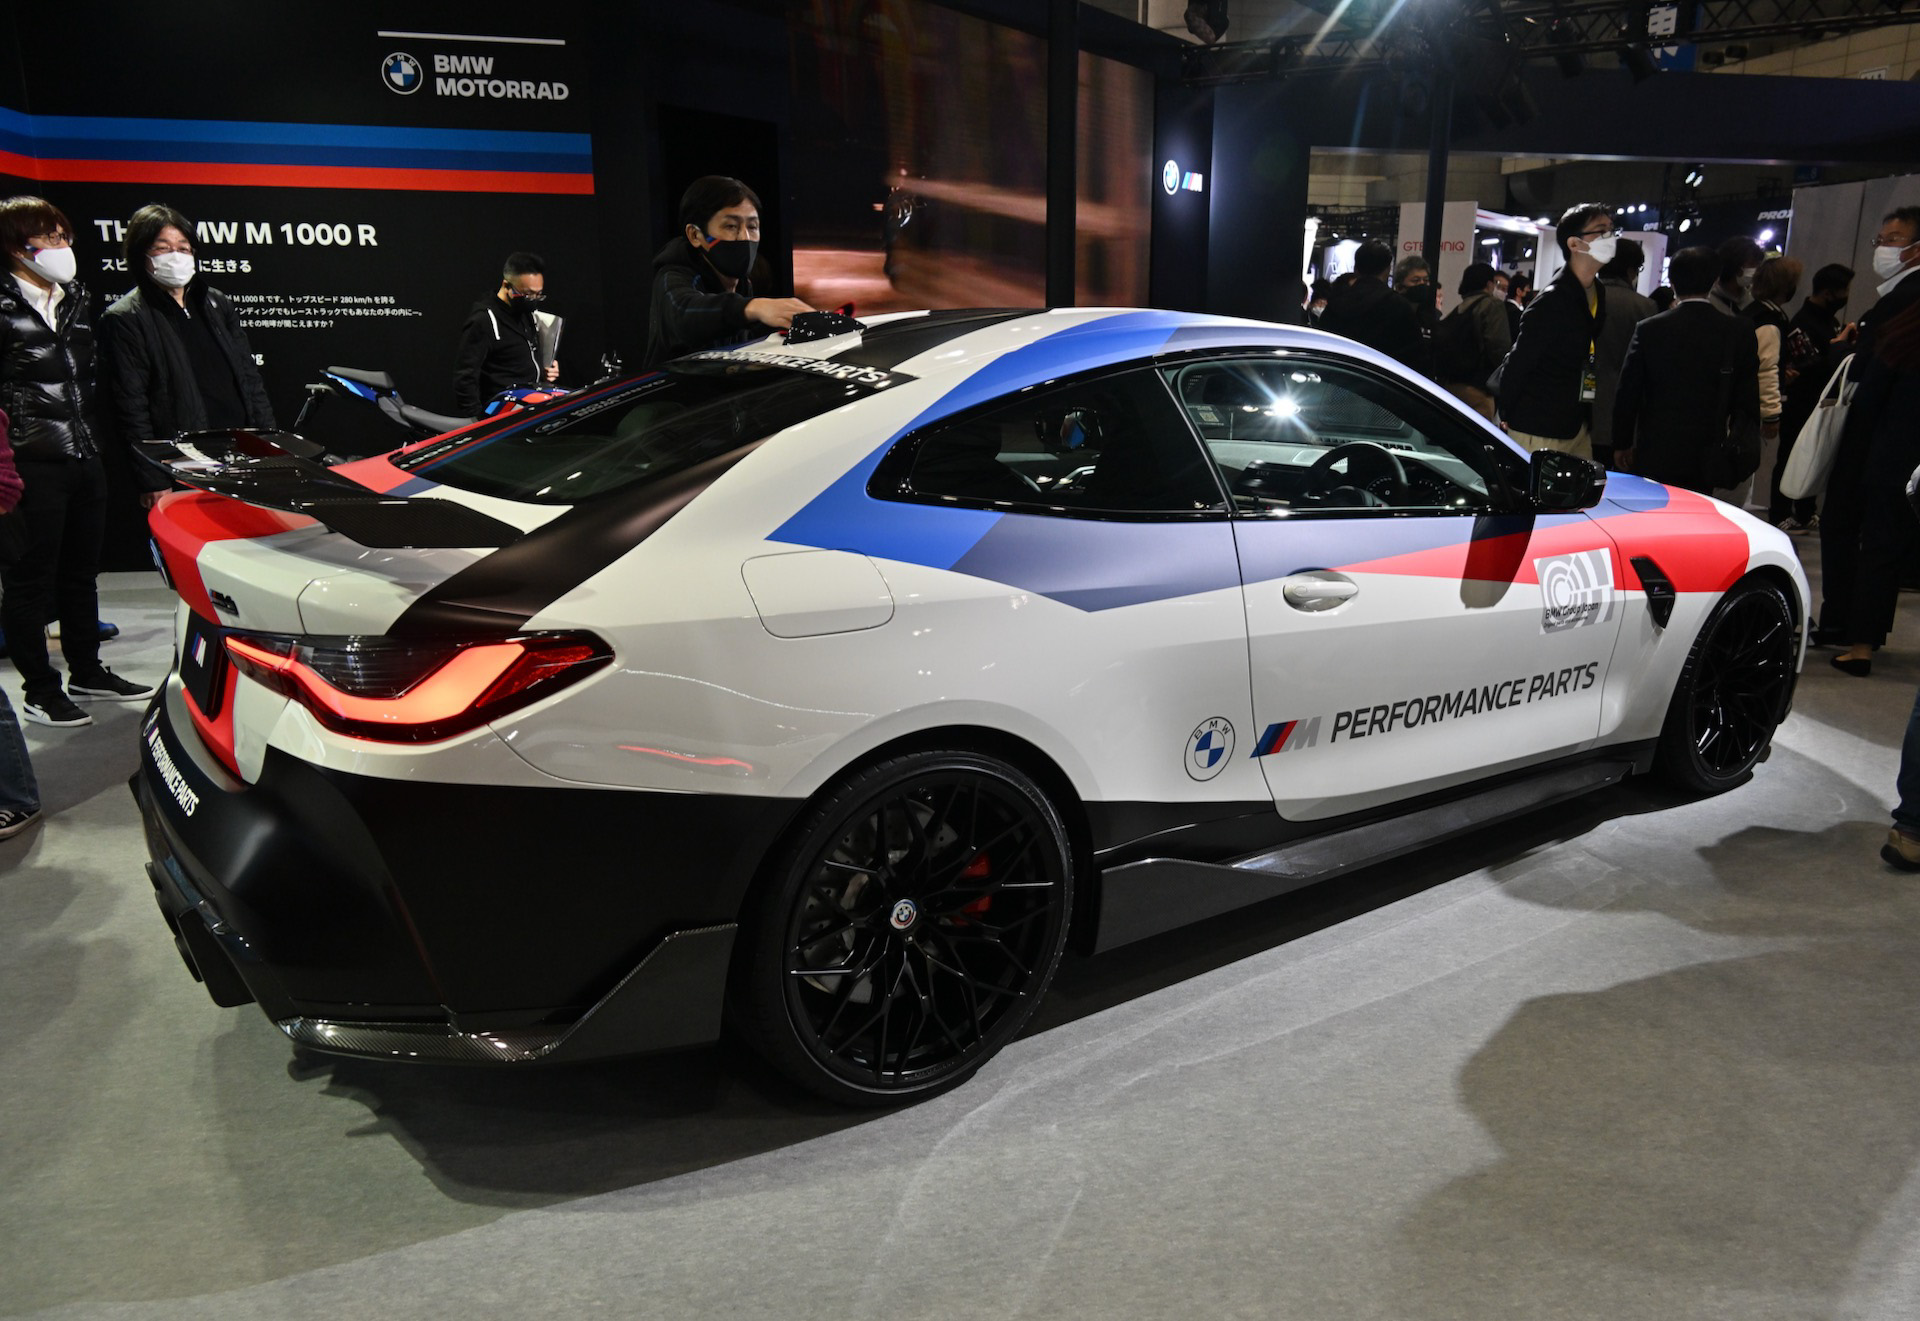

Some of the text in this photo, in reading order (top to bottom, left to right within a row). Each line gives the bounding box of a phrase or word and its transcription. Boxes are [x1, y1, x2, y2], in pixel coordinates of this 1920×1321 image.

[434, 54, 494, 75] BMW
[436, 77, 569, 100] MOTORRAD
[94, 219, 127, 242] TH
[245, 222, 273, 244] M
[280, 223, 351, 246] 1000
[358, 224, 378, 246] R
[802, 359, 887, 382] PARTS
[1545, 607, 1561, 620] BMW
[1330, 678, 1527, 743] PERFORMANCE
[1526, 661, 1599, 704] PARTS
[174, 779, 200, 817] PARTS
